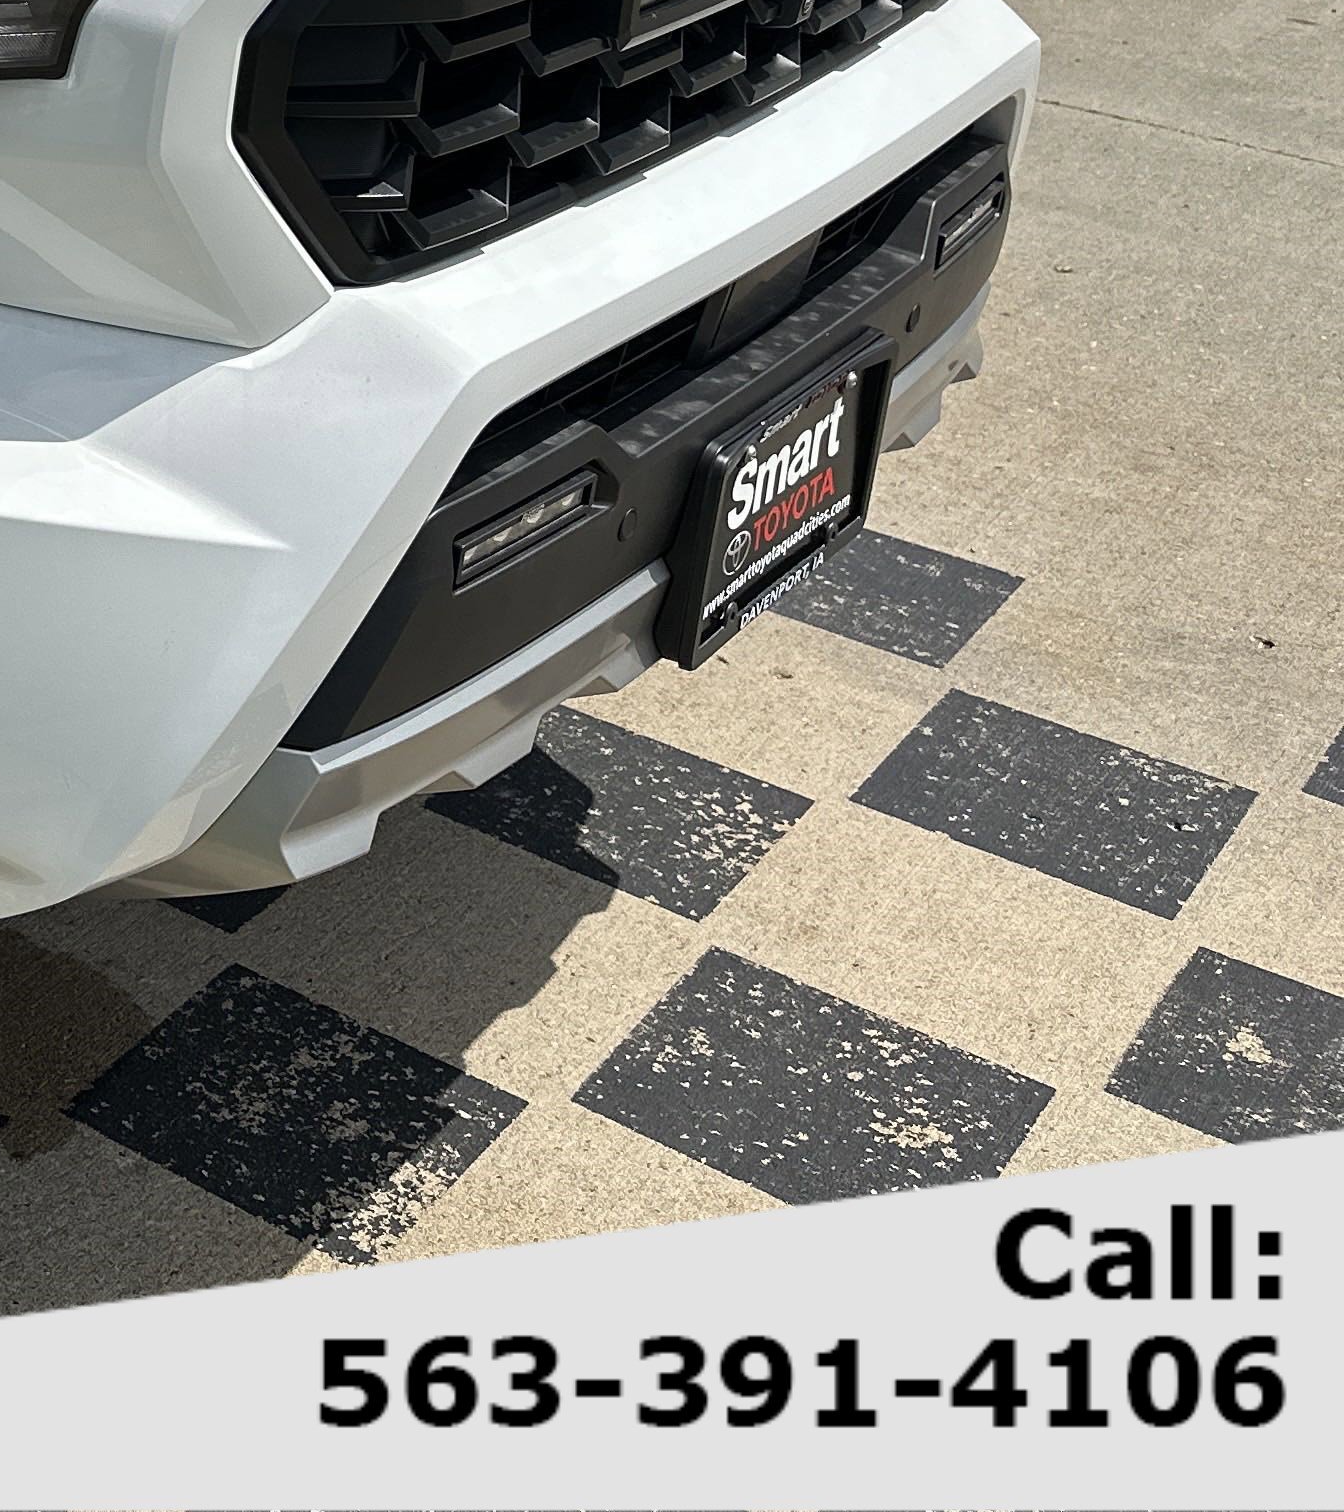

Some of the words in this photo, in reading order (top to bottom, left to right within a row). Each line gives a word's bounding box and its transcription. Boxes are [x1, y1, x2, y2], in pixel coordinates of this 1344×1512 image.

[727, 396, 845, 530] Smart
[753, 466, 837, 552] TOYOTA
[739, 563, 810, 630] DAVENPORT,
[812, 551, 824, 571] IA
